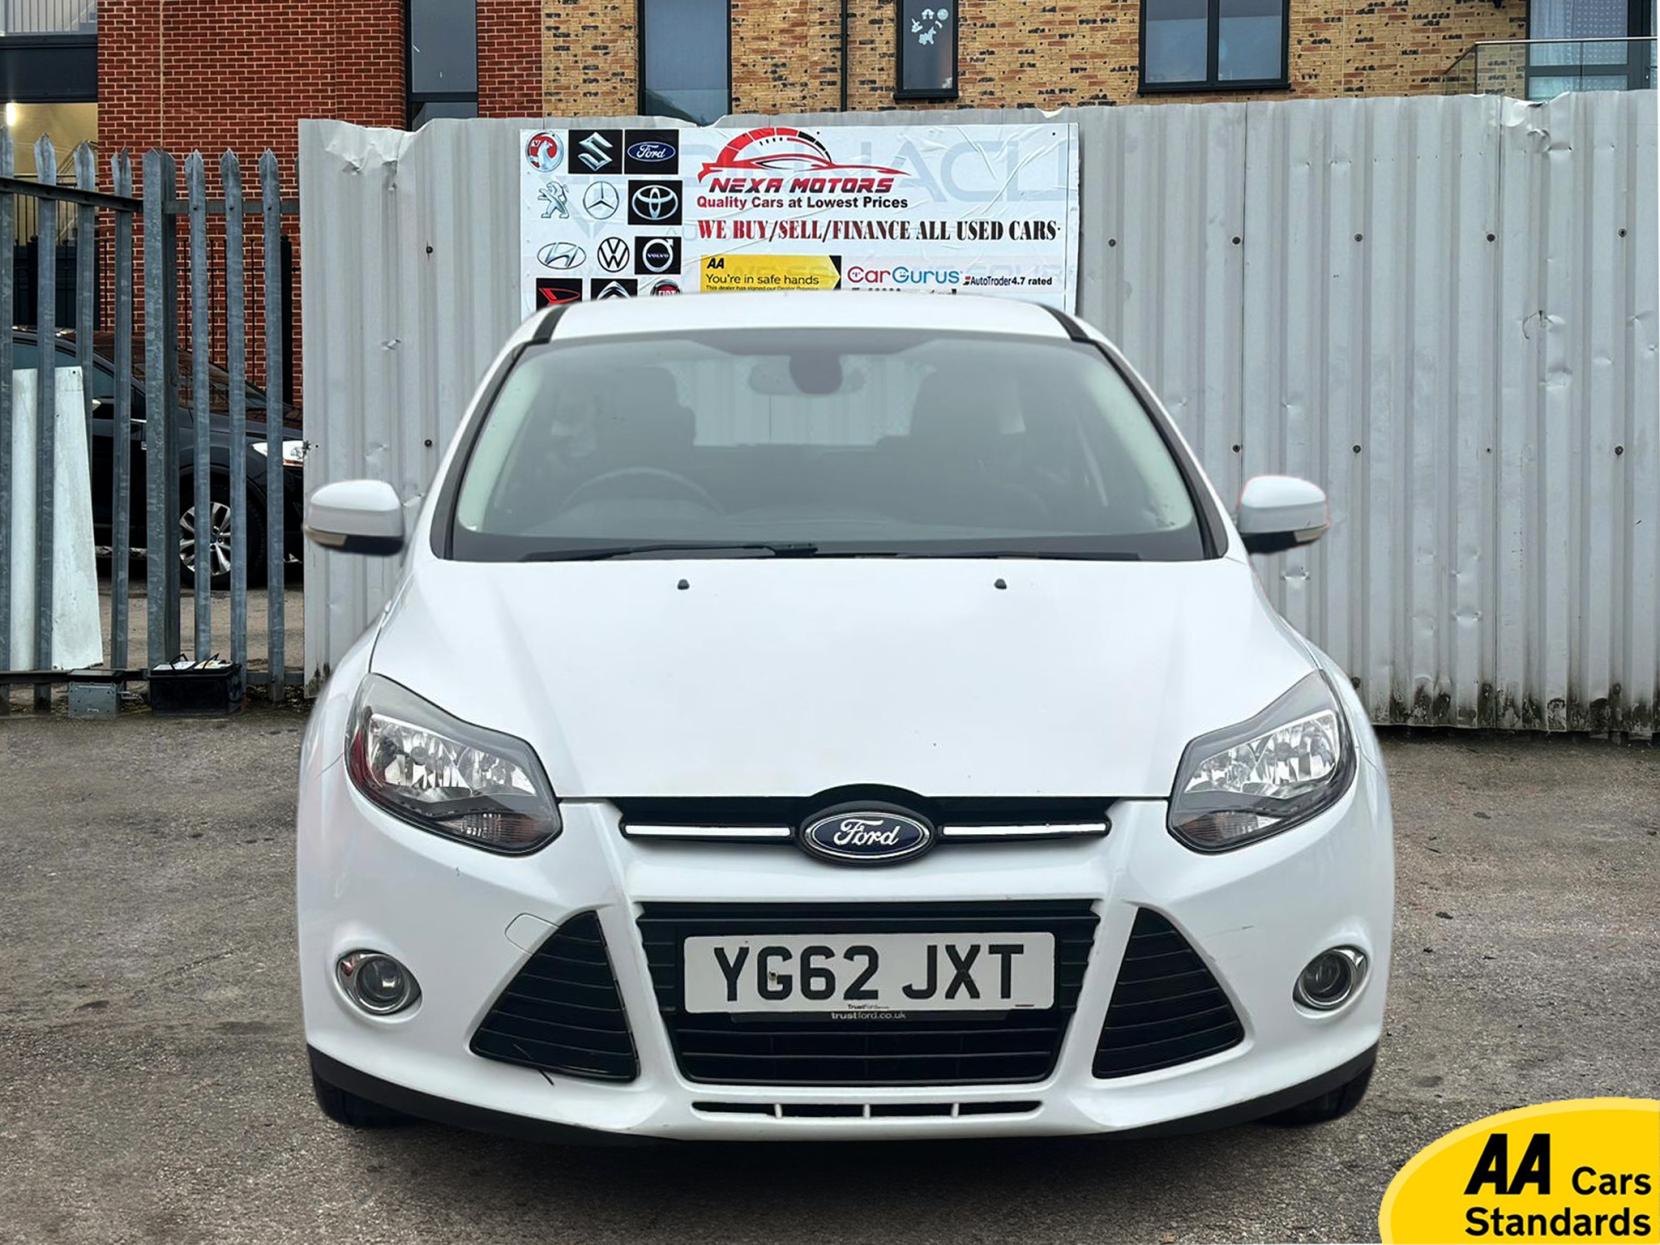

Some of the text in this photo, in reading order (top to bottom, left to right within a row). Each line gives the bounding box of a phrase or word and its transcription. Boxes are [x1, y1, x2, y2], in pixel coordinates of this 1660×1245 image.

[636, 145, 665, 159] Ford
[709, 178, 894, 193] NEXA MOTORS
[697, 196, 908, 210] Quality Cars at Lowest Prices
[698, 220, 726, 240] WE
[916, 220, 950, 241] ALL
[957, 220, 1003, 241] USED
[1009, 220, 1057, 241] CARS
[706, 258, 725, 269] AA
[705, 274, 819, 285] You're in safe hands
[847, 266, 960, 284] CarGurus
[1028, 277, 1052, 285] rated
[833, 819, 901, 845] Ford
[714, 944, 1024, 1001] YG62 JXT
[831, 1011, 906, 1020] trustford.co.uk
